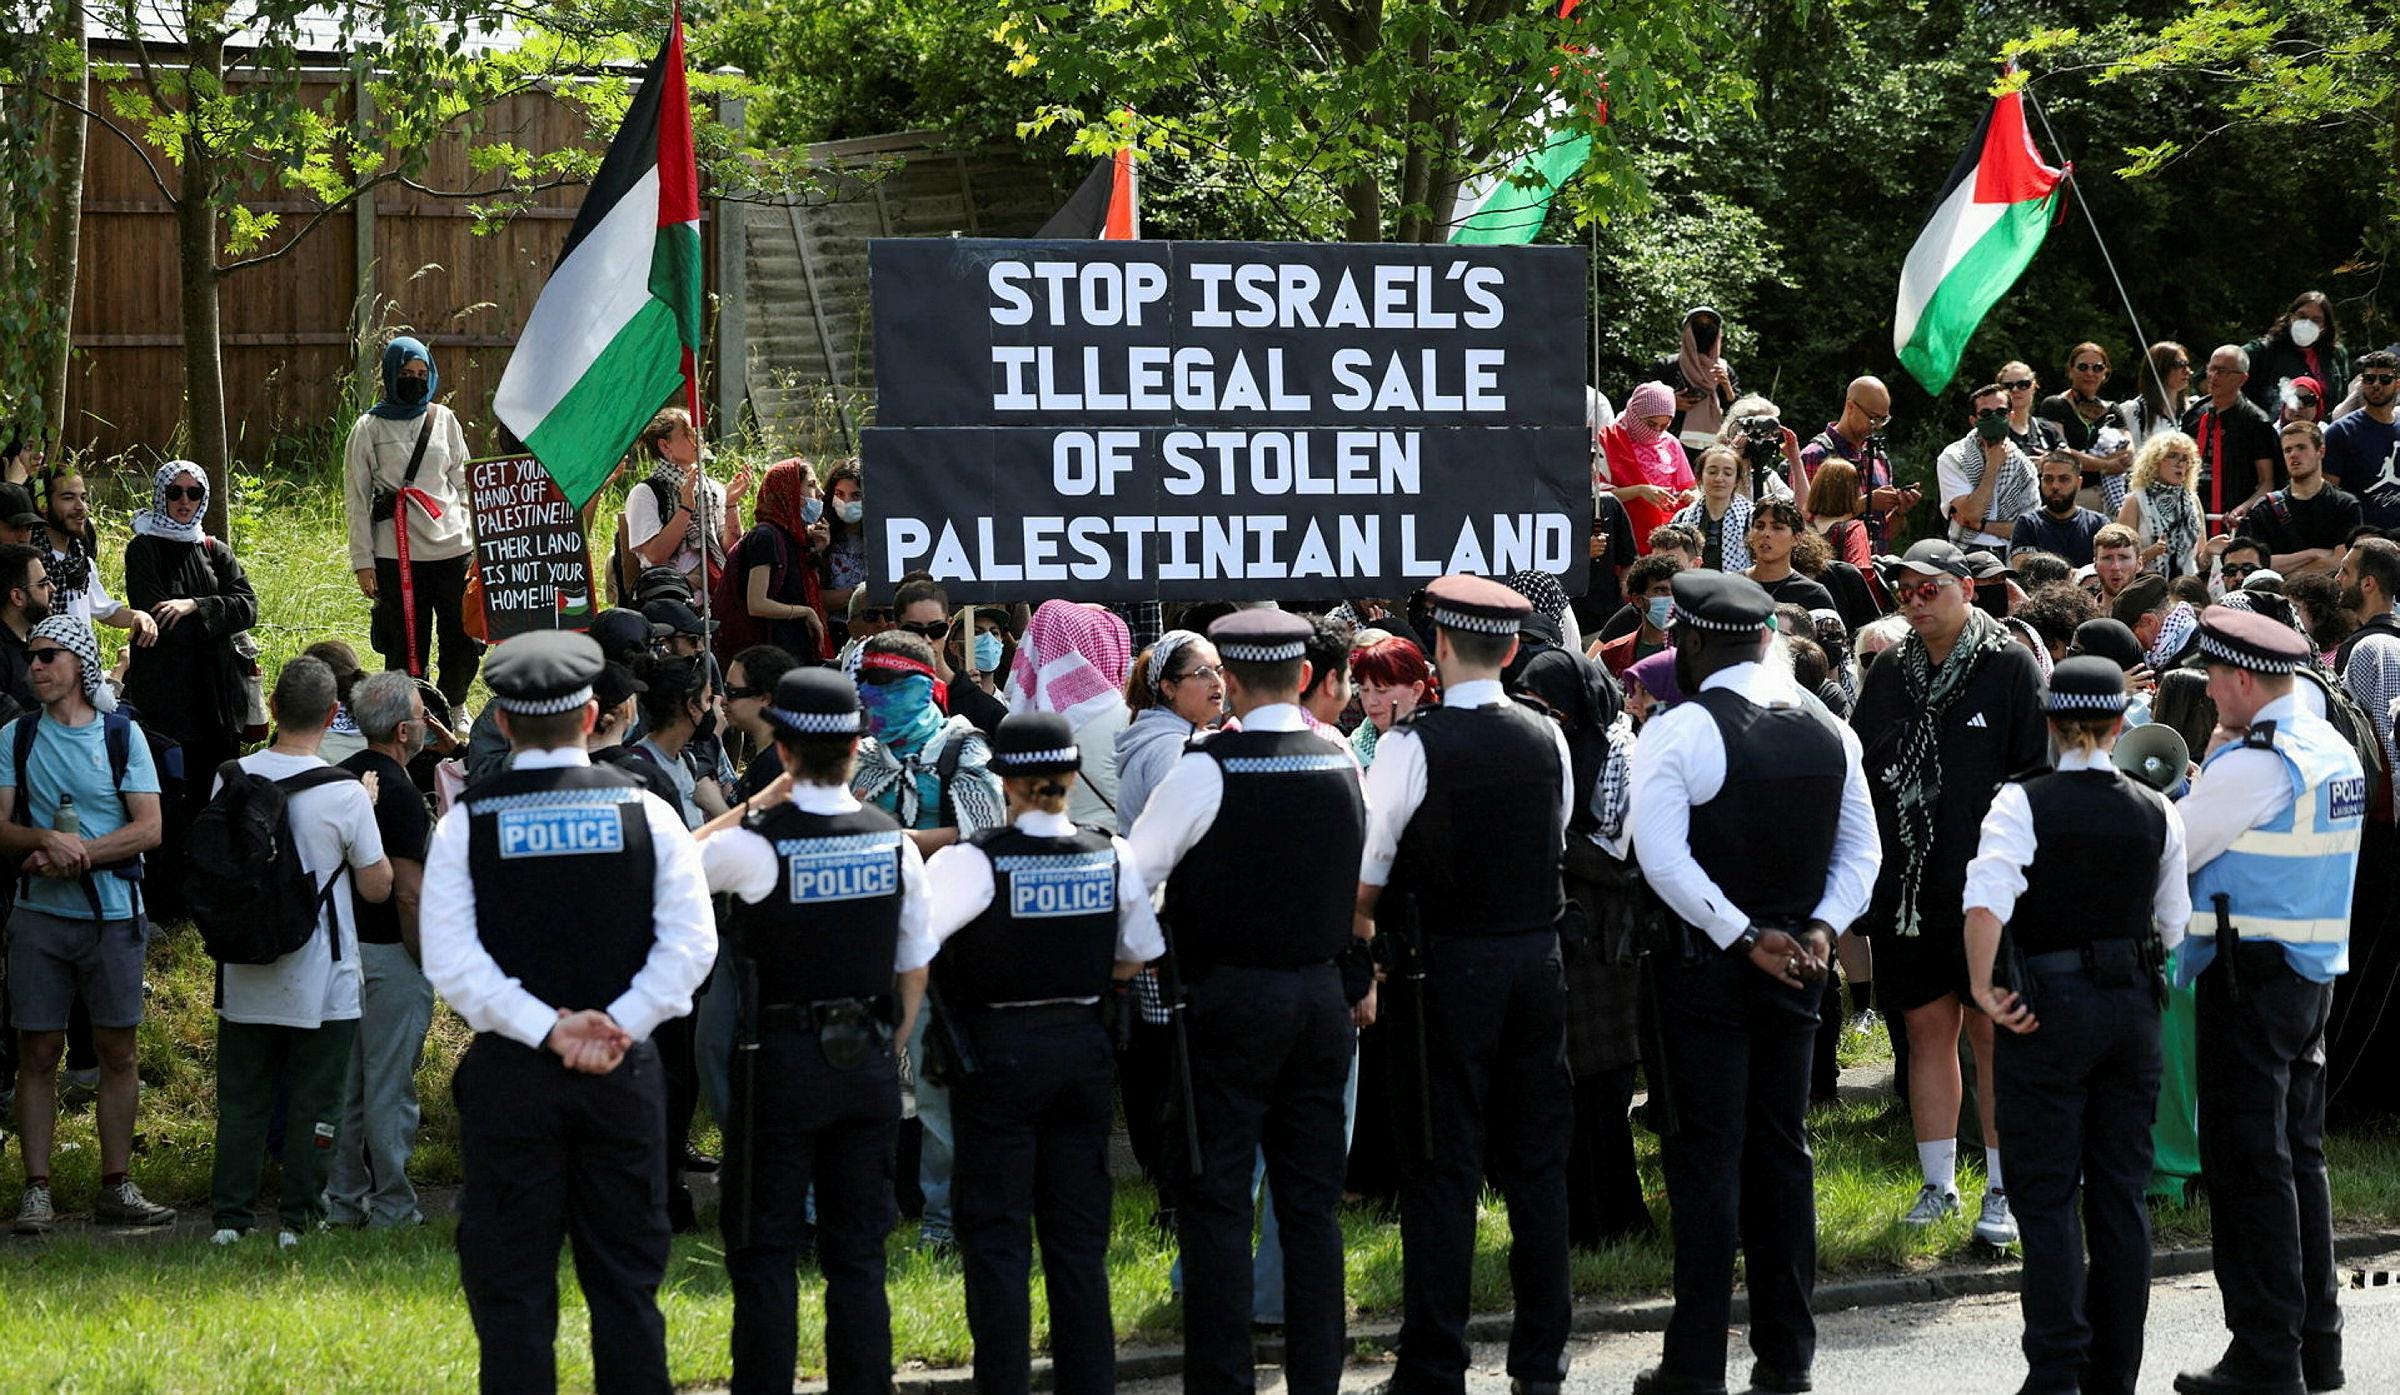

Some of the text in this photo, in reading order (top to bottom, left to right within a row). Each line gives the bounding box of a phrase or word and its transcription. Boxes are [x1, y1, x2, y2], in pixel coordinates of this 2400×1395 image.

[989, 261, 1503, 328] STOP ISRAEL'S
[992, 347, 1505, 410] ILLEGAL SALE
[474, 462, 508, 489] GET
[1054, 432, 1420, 495] OF STOLEN
[474, 481, 547, 511] HANDS OFF
[477, 502, 574, 537] PALESTINE!!!
[481, 532, 581, 561] THEIR LAND
[887, 514, 1571, 582] PALESTINIAN LAND
[482, 561, 585, 586] IS NOT YOUR
[490, 585, 555, 611] HOME!!!
[504, 820, 617, 853] POLICE
[796, 864, 893, 897] POLICE
[1016, 880, 1112, 912] POLICE
